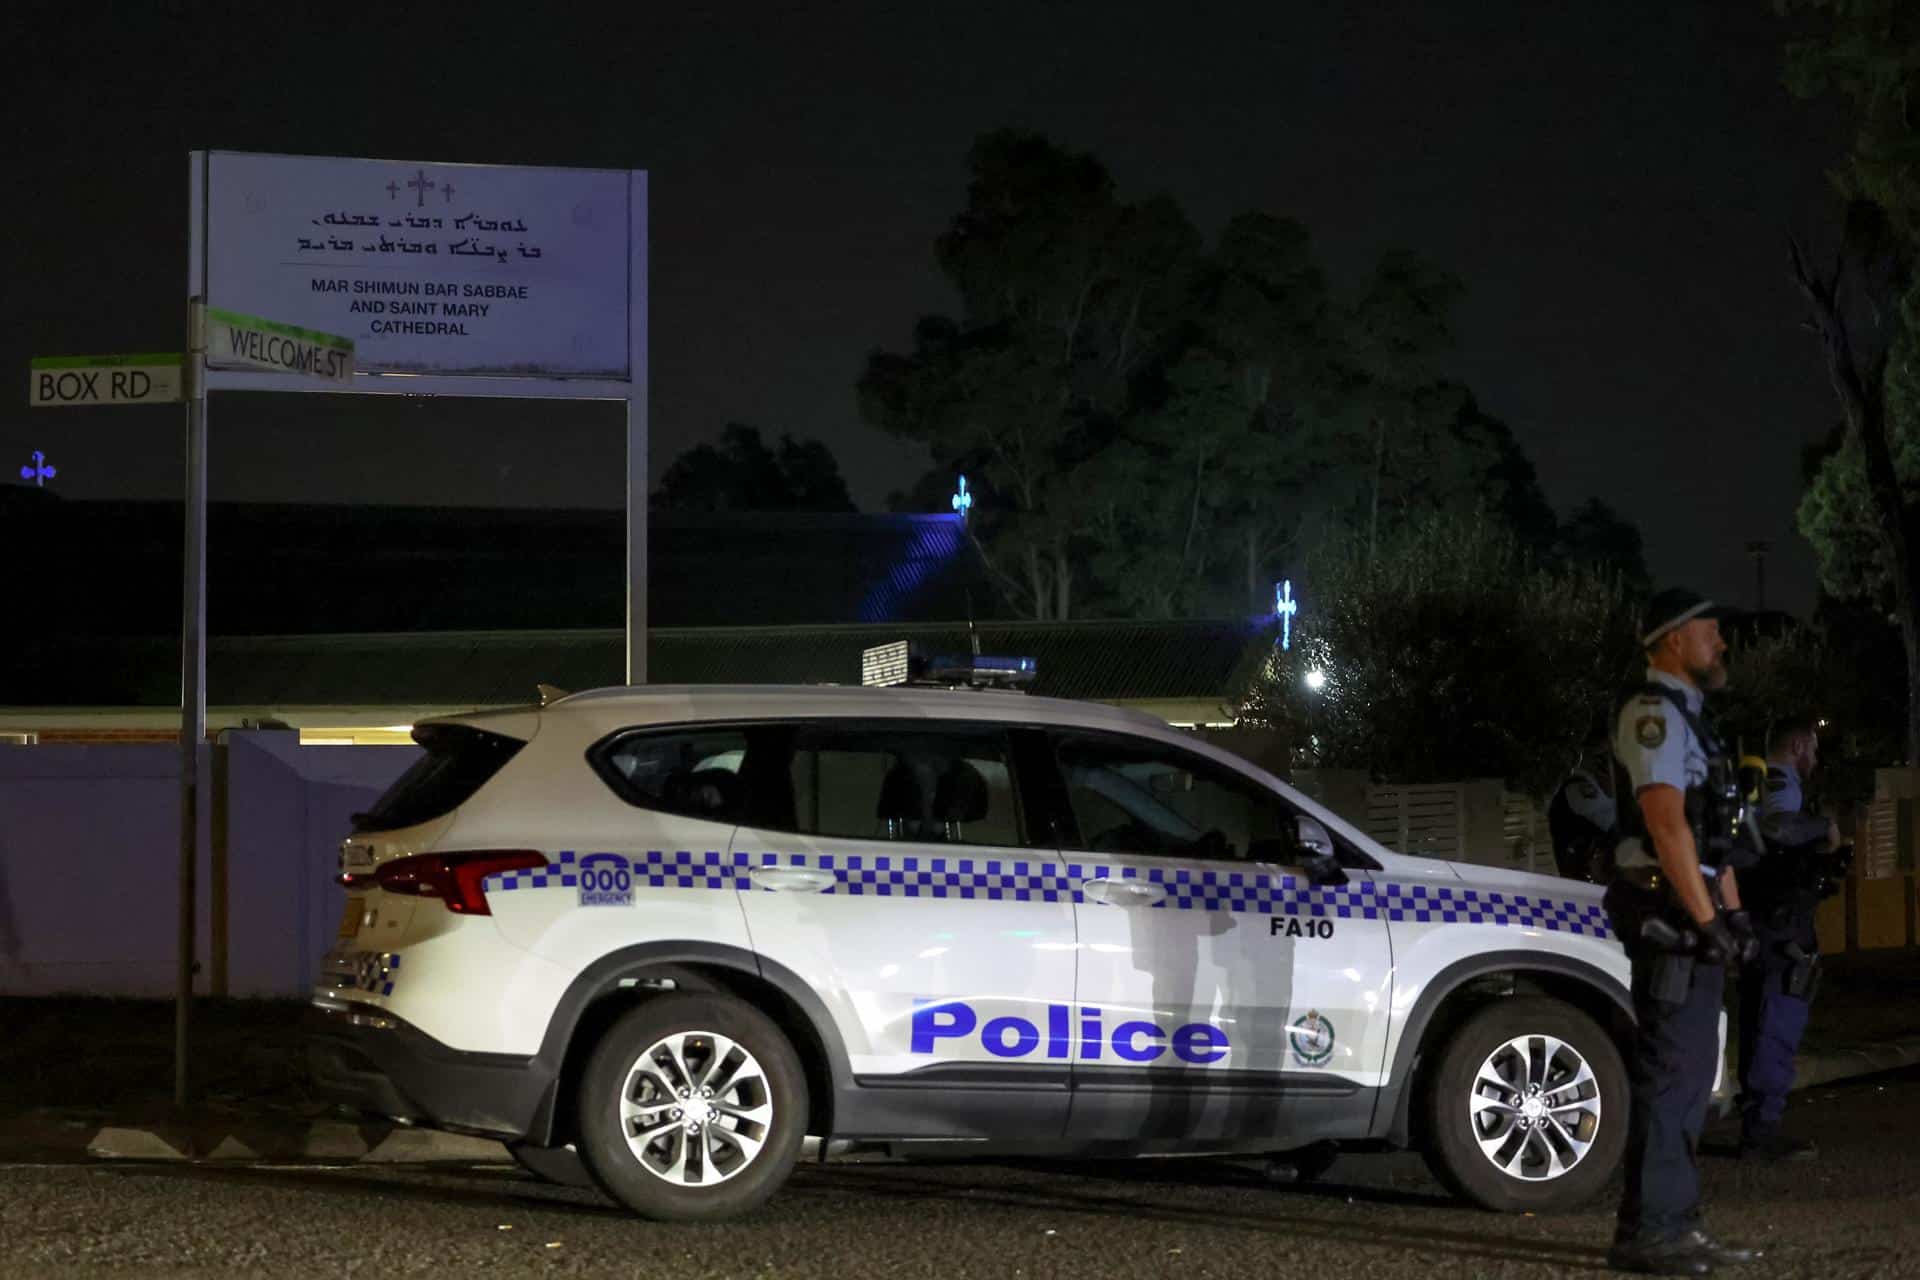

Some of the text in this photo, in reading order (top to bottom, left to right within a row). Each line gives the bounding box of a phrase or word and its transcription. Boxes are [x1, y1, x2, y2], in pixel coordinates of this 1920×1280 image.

[311, 279, 529, 300] MAR SHIMUN BAR SABBAE
[349, 299, 489, 318] AND SAINT MARY
[370, 319, 470, 336] CATHEDRAL
[230, 328, 347, 379] WELCOME ST
[39, 371, 151, 401] BOX RD
[581, 869, 631, 891] 000
[1270, 917, 1334, 940] FA10
[910, 998, 1230, 1064] Police
